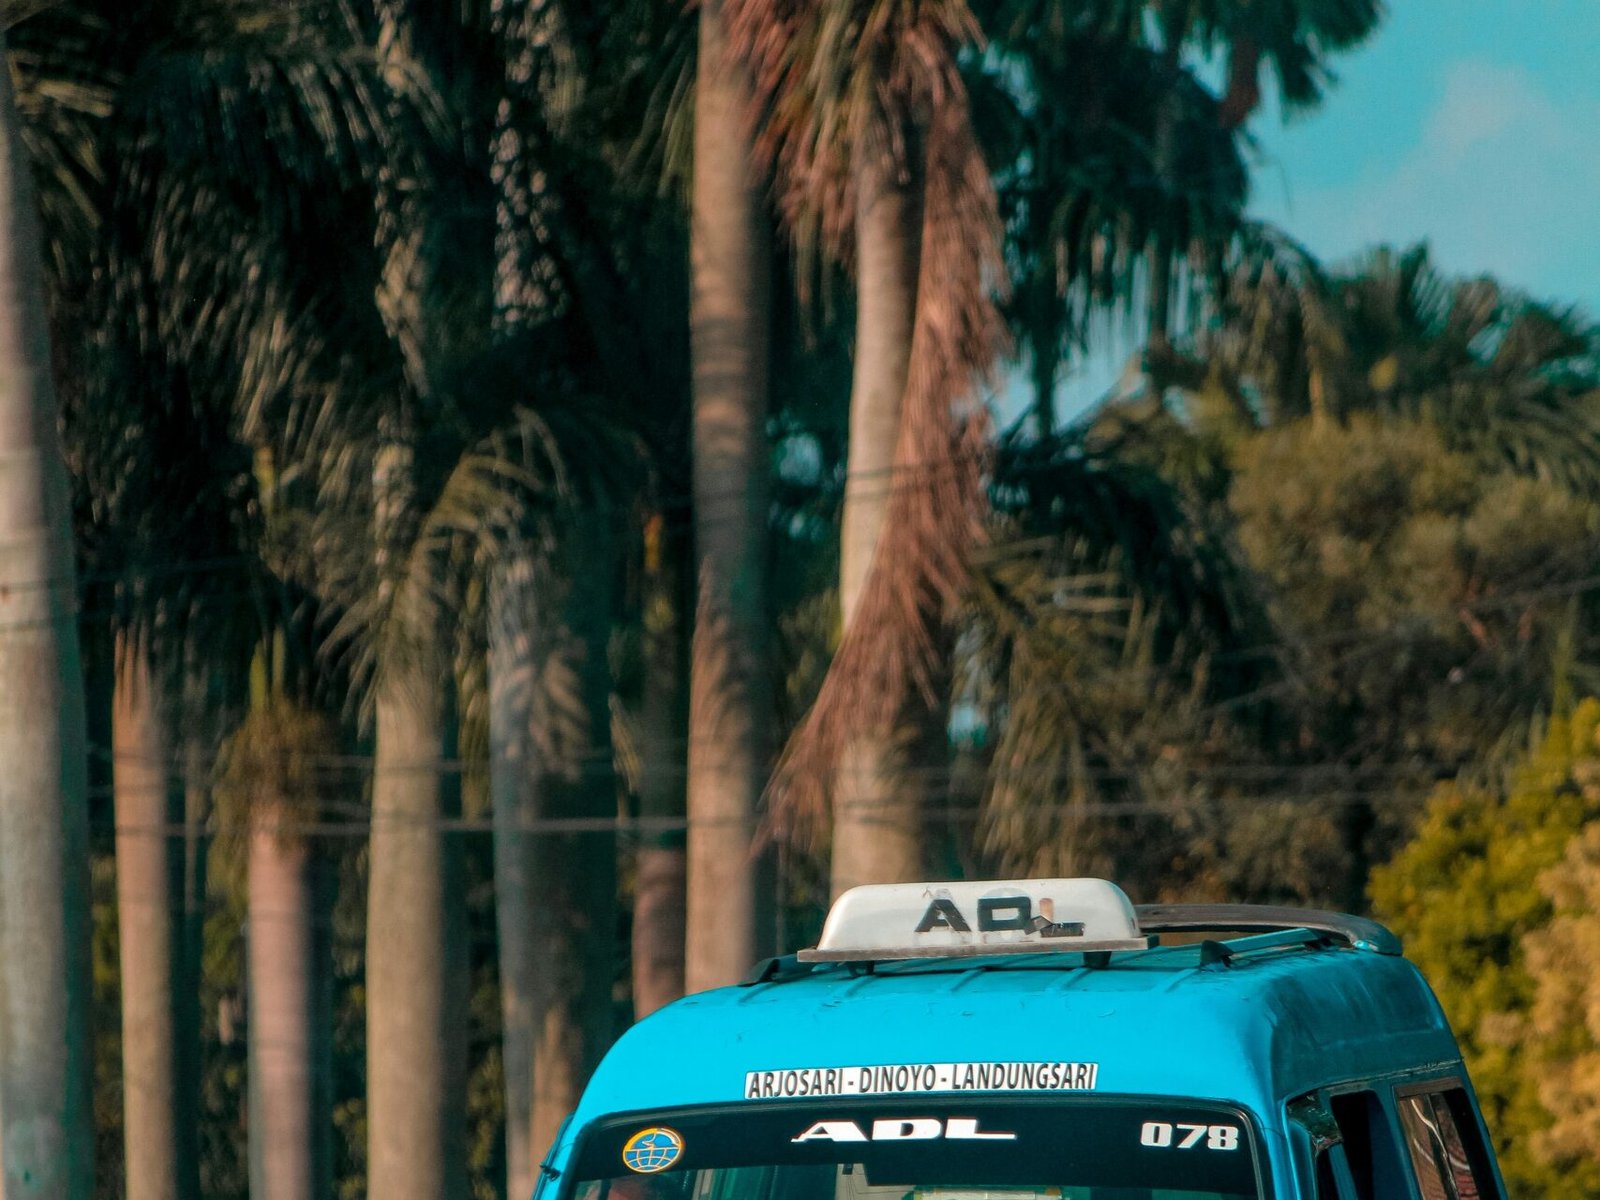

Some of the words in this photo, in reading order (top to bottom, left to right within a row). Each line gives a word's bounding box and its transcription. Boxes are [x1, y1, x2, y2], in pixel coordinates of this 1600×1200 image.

[748, 1072, 843, 1098] ARJOSARI
[858, 1064, 937, 1093] DINOYO
[951, 1063, 1095, 1090] LANDUNGSARI
[791, 1118, 1018, 1142] ADL
[1140, 1122, 1240, 1151] 078
